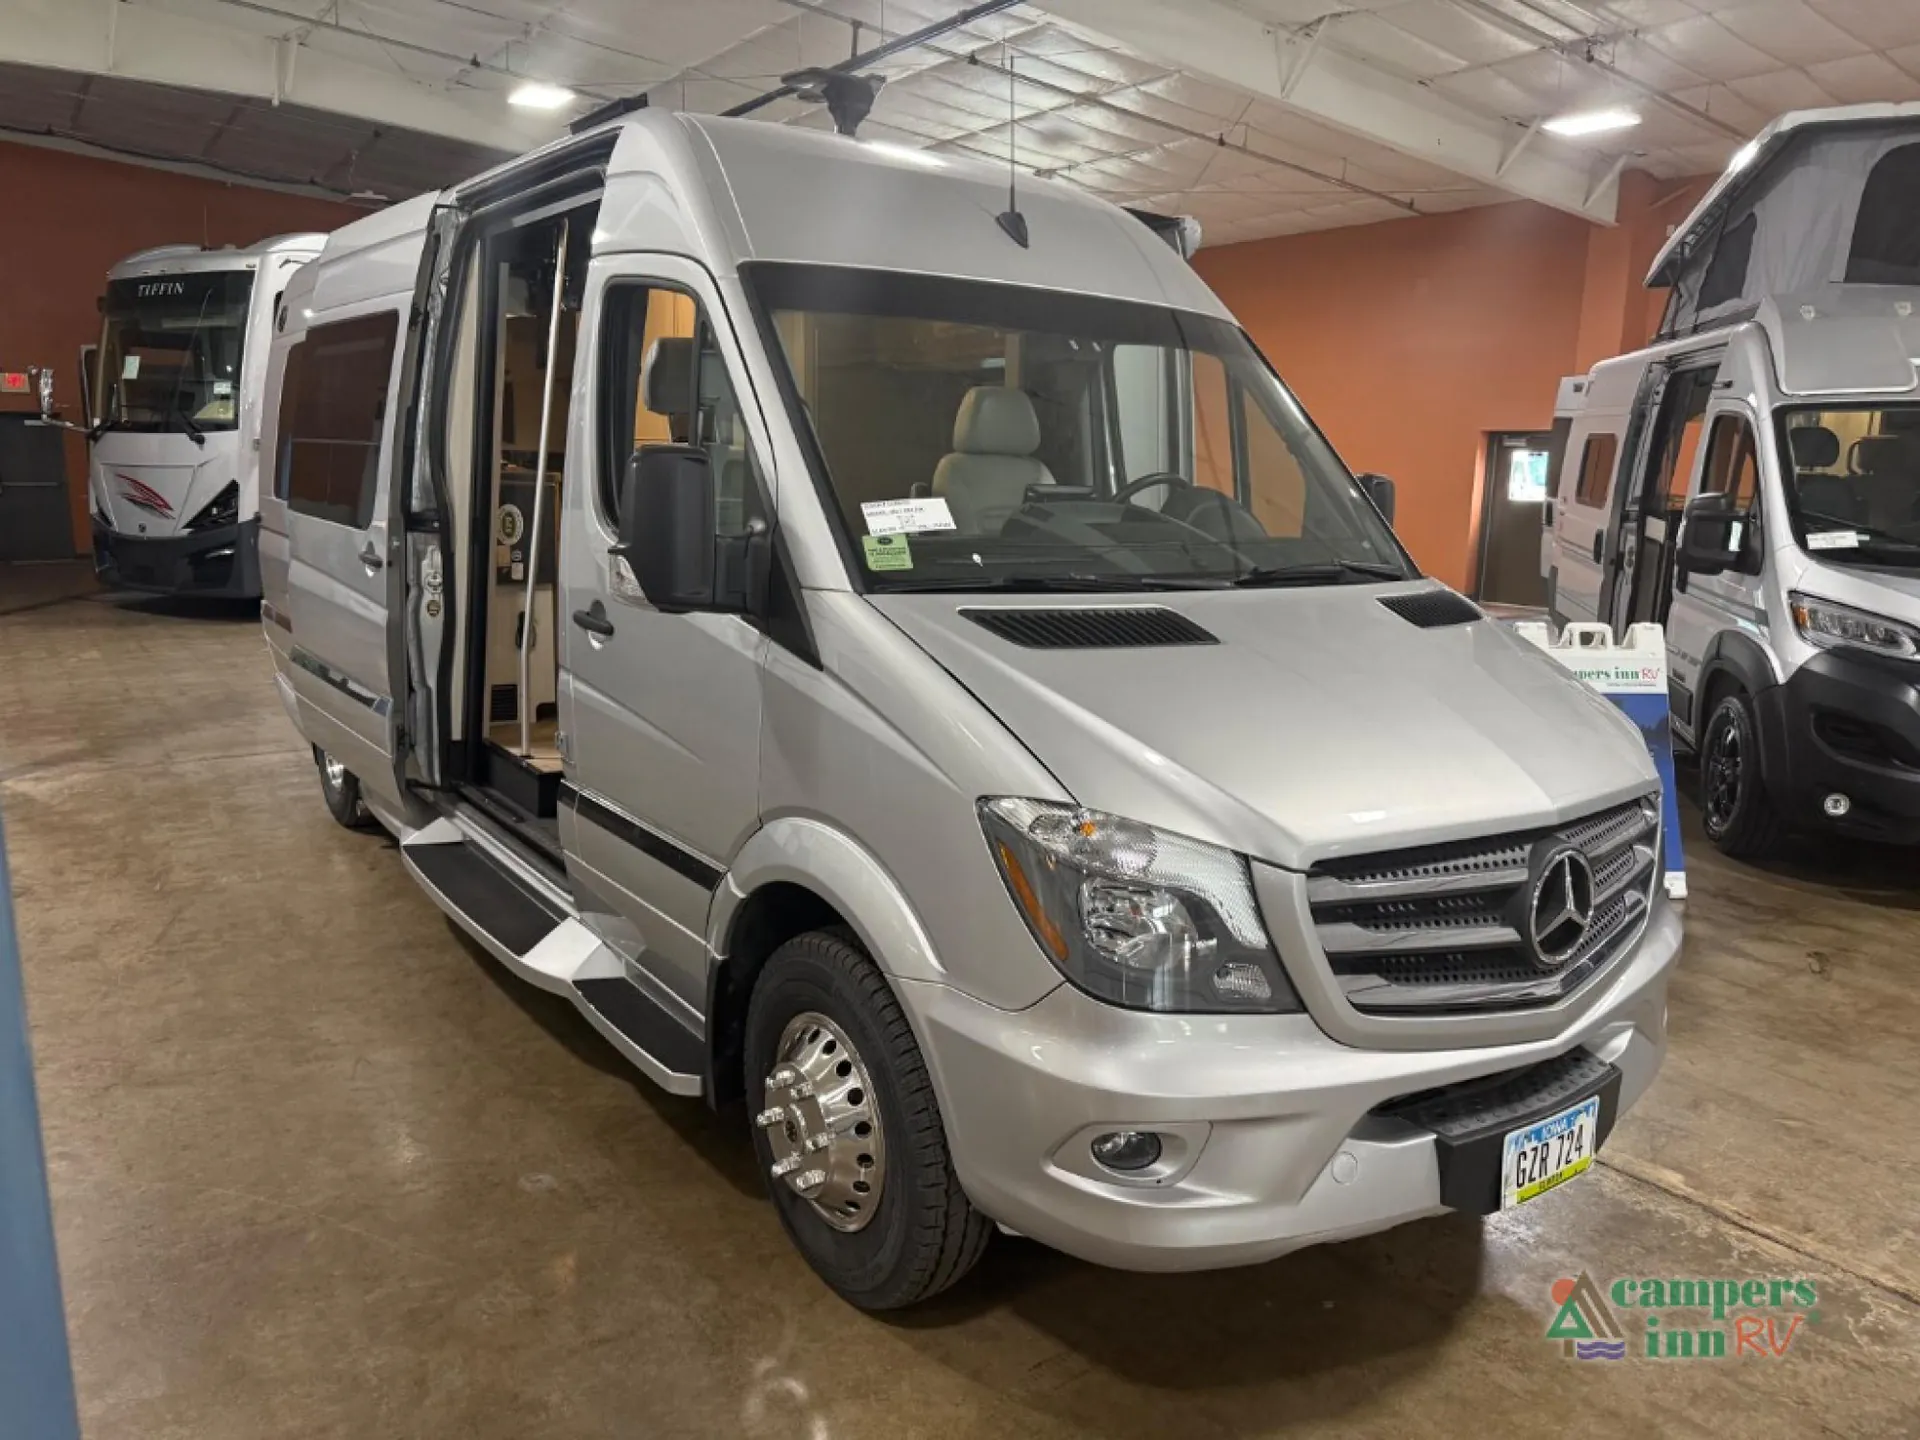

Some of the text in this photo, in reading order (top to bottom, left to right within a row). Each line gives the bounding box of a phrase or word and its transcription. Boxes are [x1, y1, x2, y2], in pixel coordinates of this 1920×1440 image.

[137, 281, 185, 297] TIFFIN
[1614, 665, 1640, 680] inn
[1516, 1142, 1550, 1189] GZR
[1556, 1123, 1584, 1171] 724
